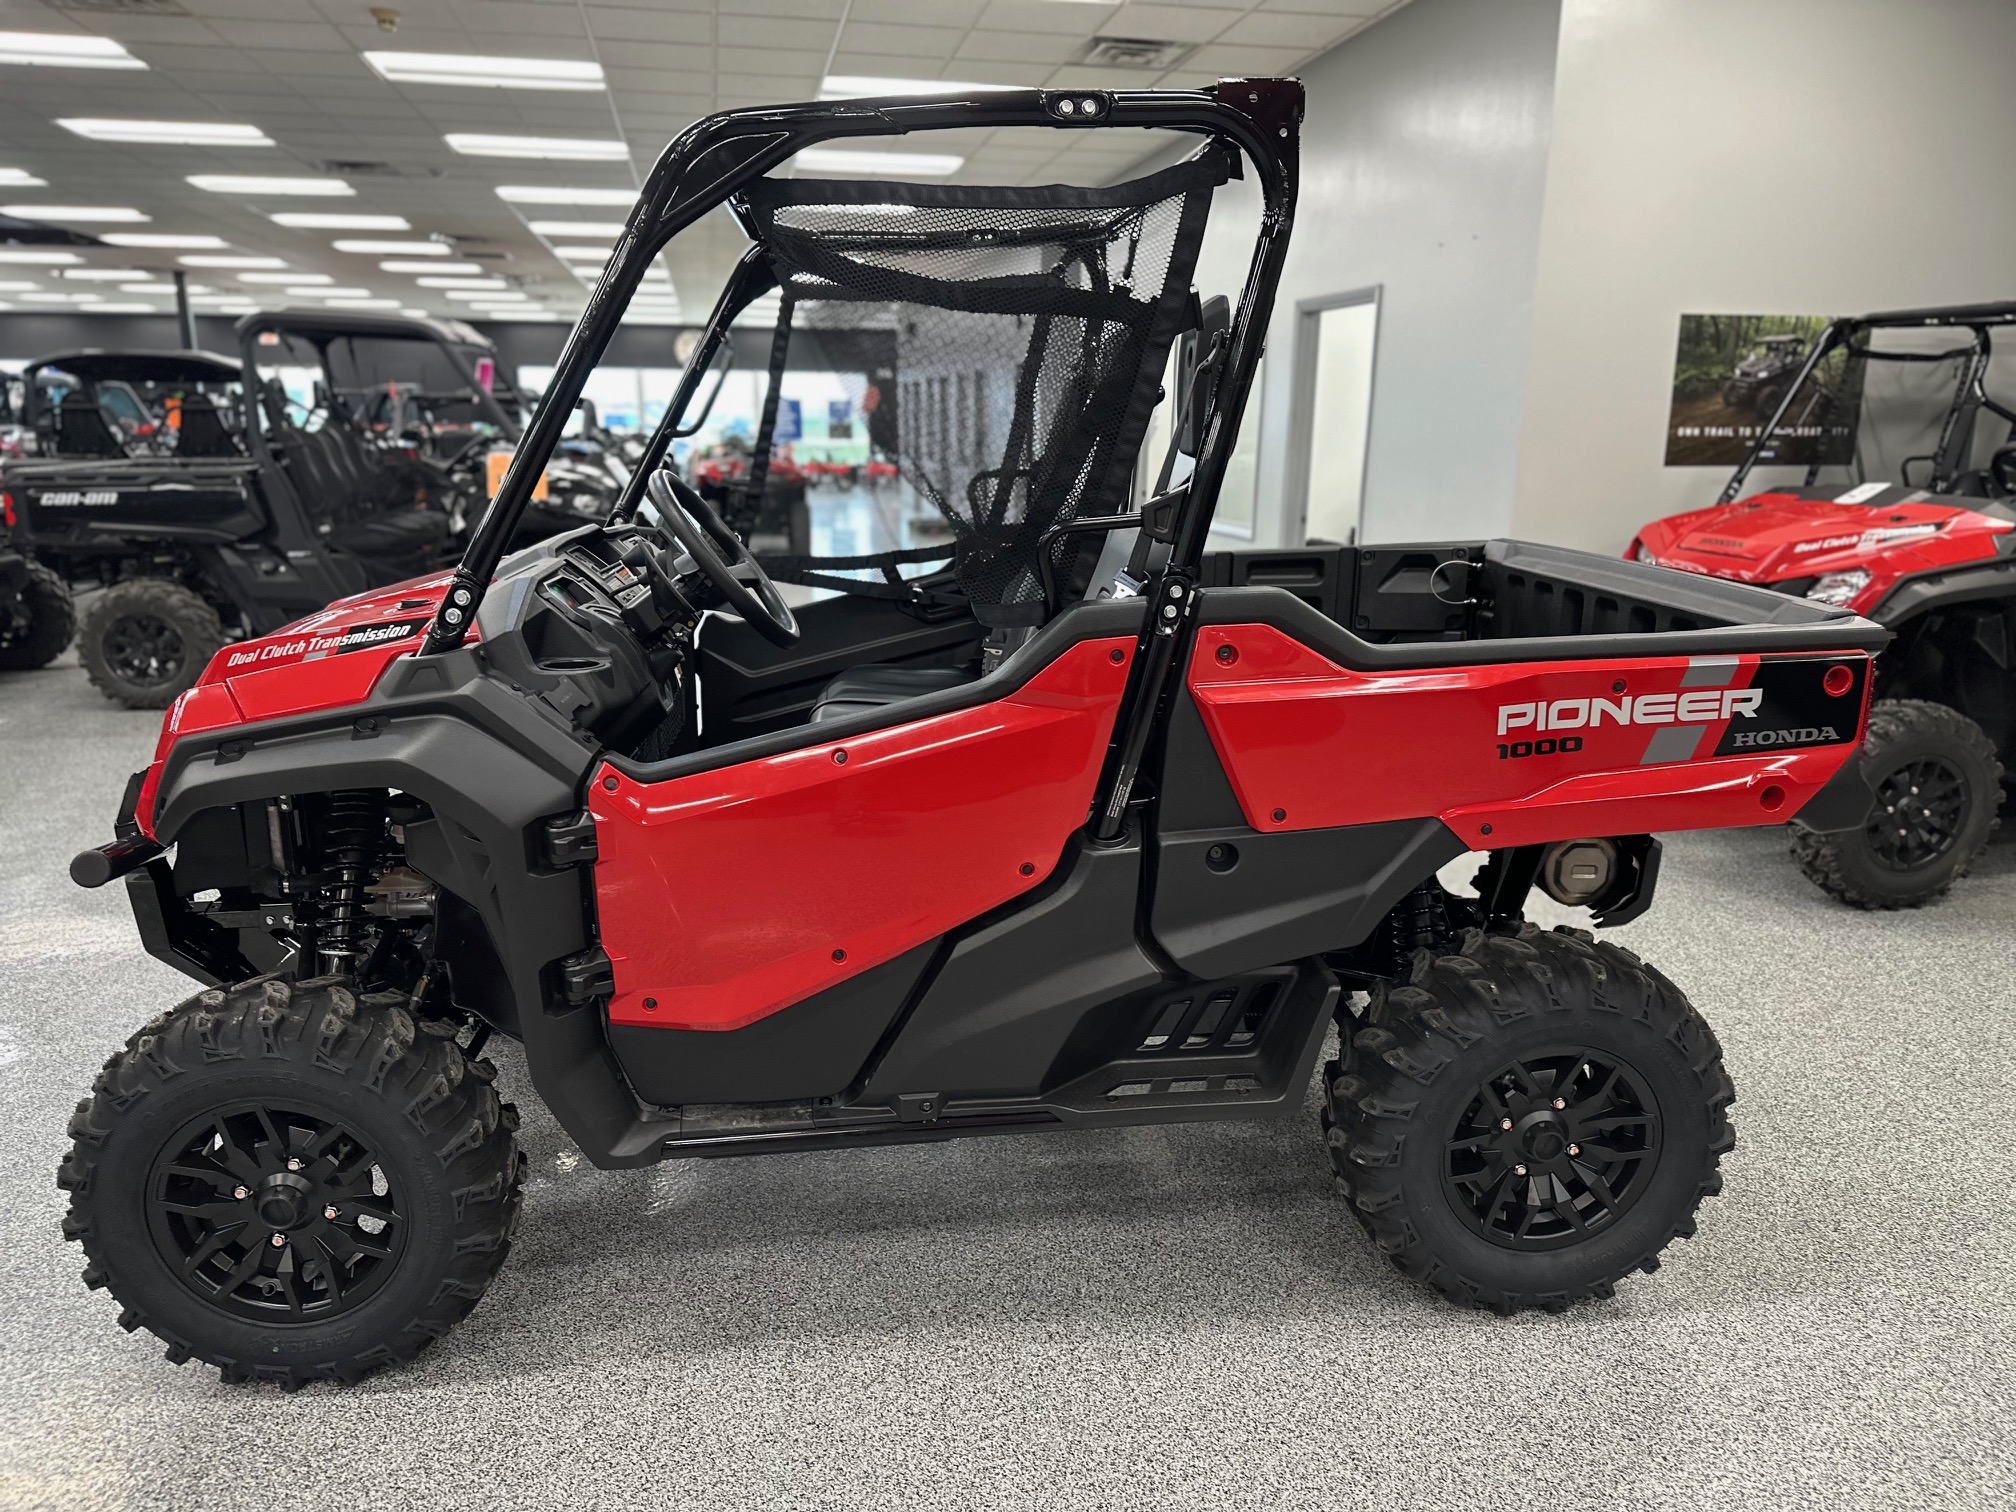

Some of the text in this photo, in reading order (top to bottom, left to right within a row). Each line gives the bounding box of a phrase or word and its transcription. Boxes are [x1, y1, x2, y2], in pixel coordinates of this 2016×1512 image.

[1739, 426, 1752, 437] TO
[1822, 533, 1859, 549] Clutch
[227, 624, 412, 667] Dual Clutch Transmission
[1497, 688, 1763, 735] PIONEER
[1497, 736, 1583, 760] 1000
[1733, 727, 1840, 747] HONDA
